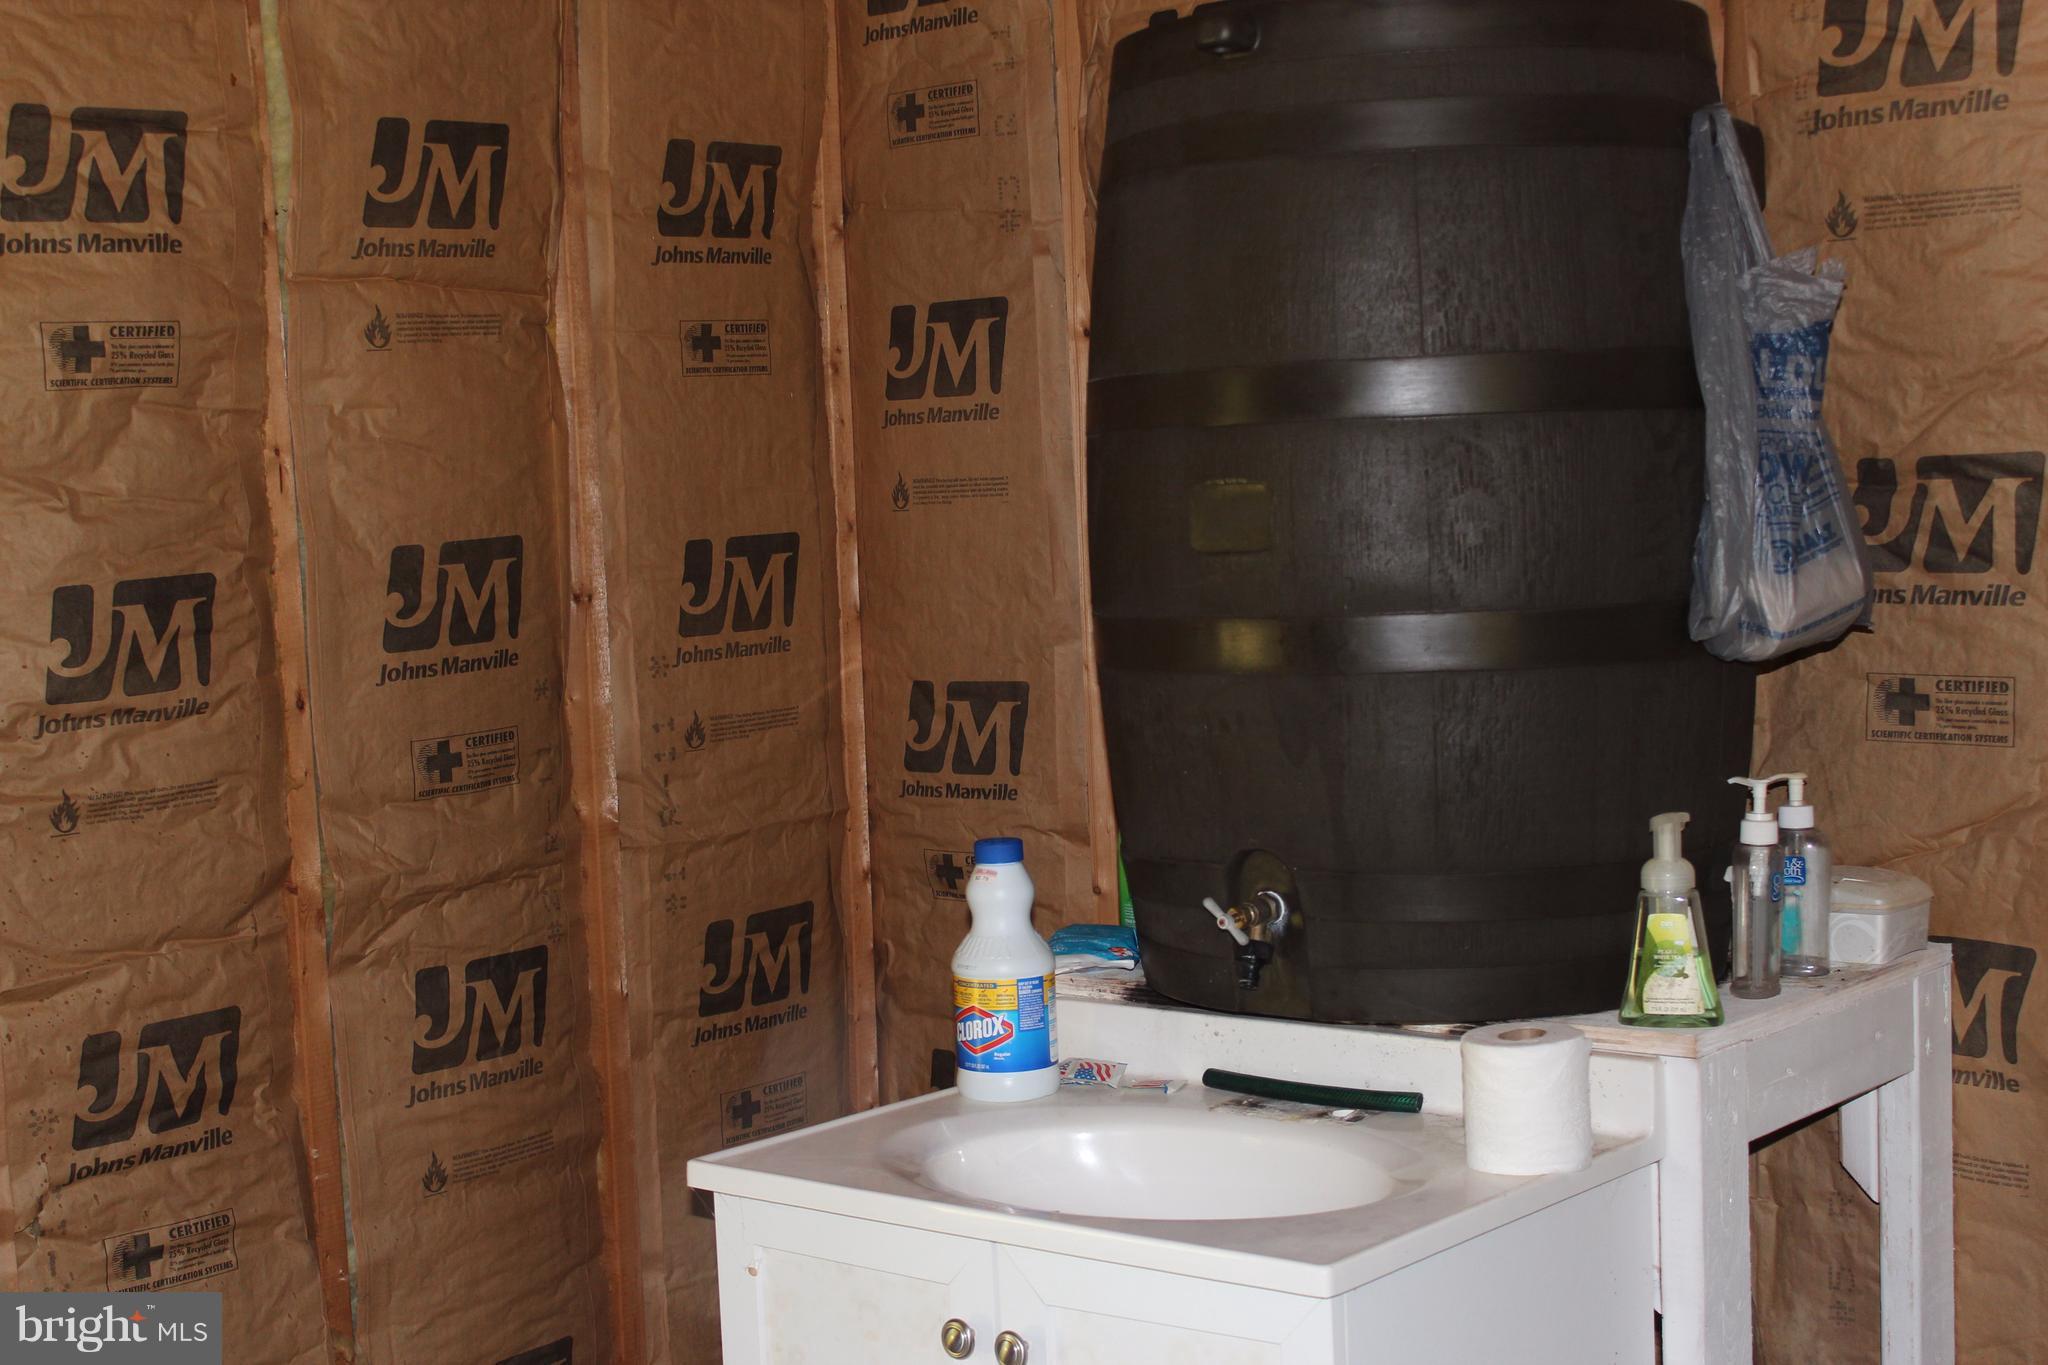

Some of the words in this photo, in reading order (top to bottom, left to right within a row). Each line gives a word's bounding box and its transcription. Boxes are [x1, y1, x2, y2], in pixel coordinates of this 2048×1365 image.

[863, 25, 909, 46] Johns
[909, 7, 978, 34] Manville
[928, 84, 973, 99] CERTIFIED
[1808, 105, 1883, 136] Johns
[1889, 89, 2010, 123] Manville
[363, 117, 509, 231] JM
[657, 138, 783, 240] JM
[77, 233, 183, 254] Manville
[352, 237, 415, 260] Johns
[418, 238, 496, 258] Manville
[651, 246, 704, 266] Johns
[706, 247, 772, 265] Manville
[110, 325, 175, 338] CERTIFIED
[725, 323, 767, 334] CERTIFIED
[129, 350, 157, 361] Recycled
[886, 296, 1008, 401] JM
[50, 378, 88, 388] SCIENTIFIC
[90, 377, 140, 387] CERTIFICATION
[882, 407, 925, 429] Johns
[927, 403, 1000, 424] Manville
[383, 535, 523, 653] JM
[679, 532, 800, 638] JM
[1911, 584, 2026, 607] Manville
[46, 573, 216, 705] JM
[672, 644, 723, 668] Johns
[725, 636, 791, 660] Manville
[376, 660, 438, 687] Johns
[441, 649, 519, 676] Manville
[1936, 680, 2009, 693] CERTIFIED
[33, 711, 105, 740] Johns
[110, 697, 209, 725] Manville
[1936, 706, 1953, 715] 25%
[1956, 706, 1986, 717] Recycled
[1988, 707, 2009, 717] Glass
[465, 731, 514, 747] CERTIFIED
[904, 680, 1030, 776] JM
[1871, 729, 1912, 740] SCIENTIFIC
[1914, 731, 1972, 742] CERTIFICATION
[1975, 734, 2009, 744] SYSTEMS
[899, 780, 943, 798] Johns
[945, 782, 1018, 800] Manville
[698, 901, 814, 1017] JM
[411, 944, 548, 1075] JM
[690, 1018, 742, 1048] Johns
[745, 1004, 807, 1033] Manville
[956, 1013, 1006, 1042] CLOROX
[72, 1005, 241, 1151] JM
[404, 1077, 466, 1108] Johns
[469, 1056, 543, 1092] Manville
[1951, 1067, 2021, 1093] nville
[61, 1159, 136, 1187] Johns
[138, 1127, 234, 1167] Manville
[169, 1214, 231, 1239] CERTIFIED
[152, 1268, 204, 1288] CERTIFICATION
[205, 1260, 234, 1275] SYSTEMS
